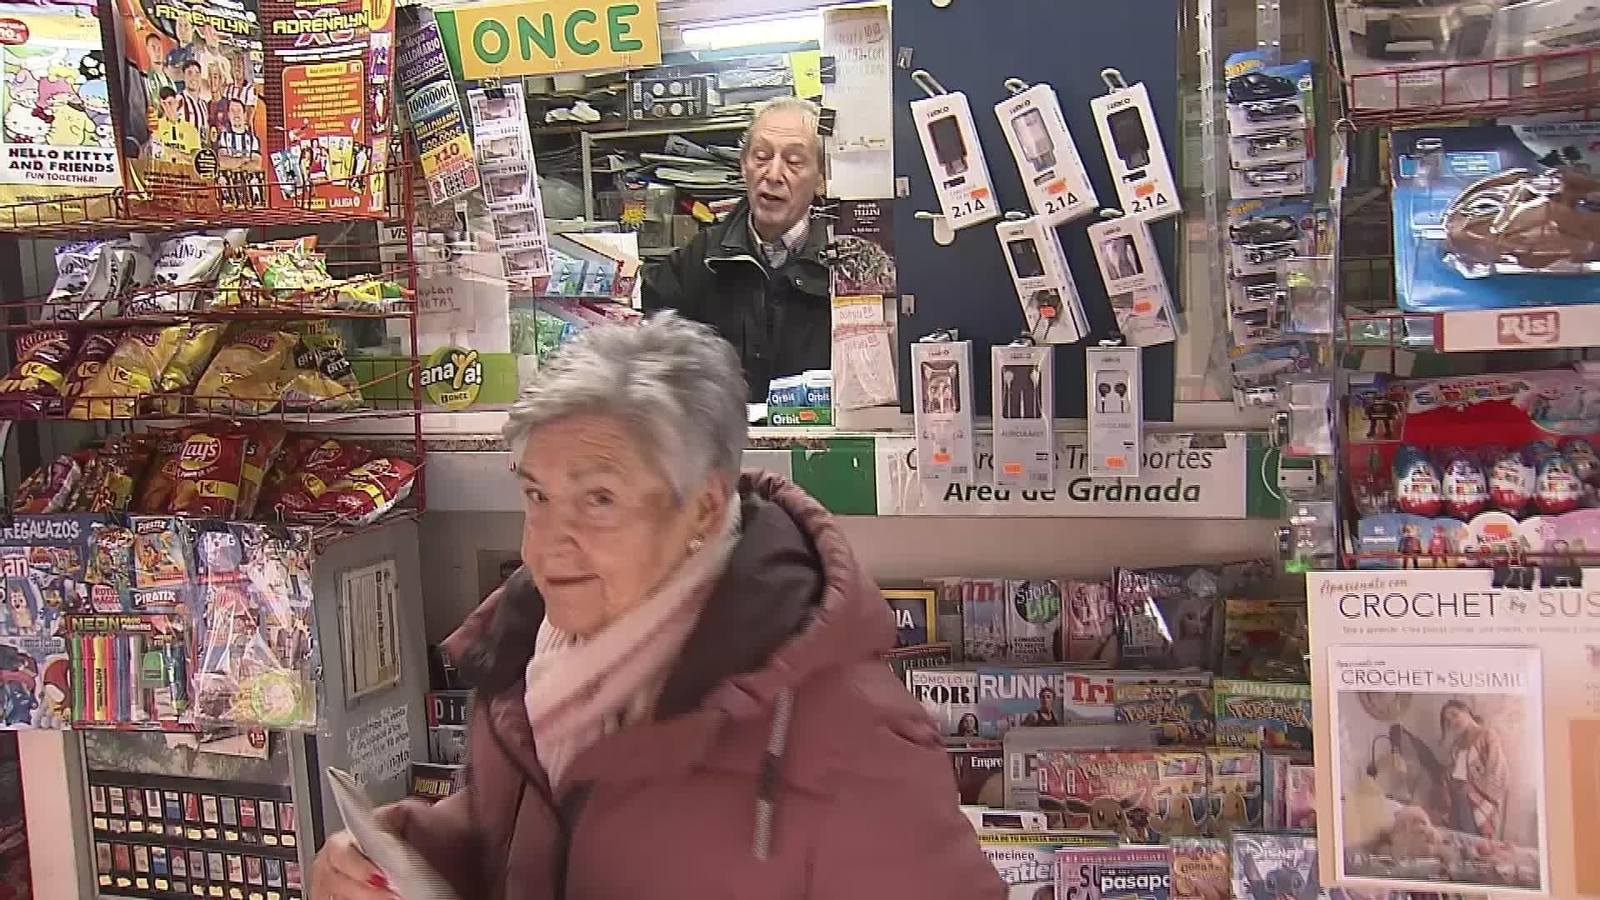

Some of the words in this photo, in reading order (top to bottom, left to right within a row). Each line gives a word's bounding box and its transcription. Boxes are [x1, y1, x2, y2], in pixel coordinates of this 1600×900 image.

[273, 9, 368, 34] ADRENALYN
[473, 5, 643, 64] ONCE
[8, 148, 59, 160] HELLO
[63, 150, 114, 161] KITTY
[8, 161, 43, 171] AND
[49, 162, 115, 173] FRIENDS
[25, 171, 45, 180] FUN
[47, 172, 98, 184] TOGETHER!
[771, 391, 795, 404] Orbit
[807, 391, 830, 403] Orbit
[772, 412, 800, 425] Orbit
[1065, 444, 1213, 470] Trortes
[1067, 476, 1201, 502] Granada
[134, 590, 177, 606] PIRATIX
[1339, 592, 1501, 619] CROCHET
[71, 616, 120, 632] NEON
[892, 609, 915, 629] IA
[1341, 669, 1433, 687] CROCHET
[983, 849, 1035, 861] Telecinco
